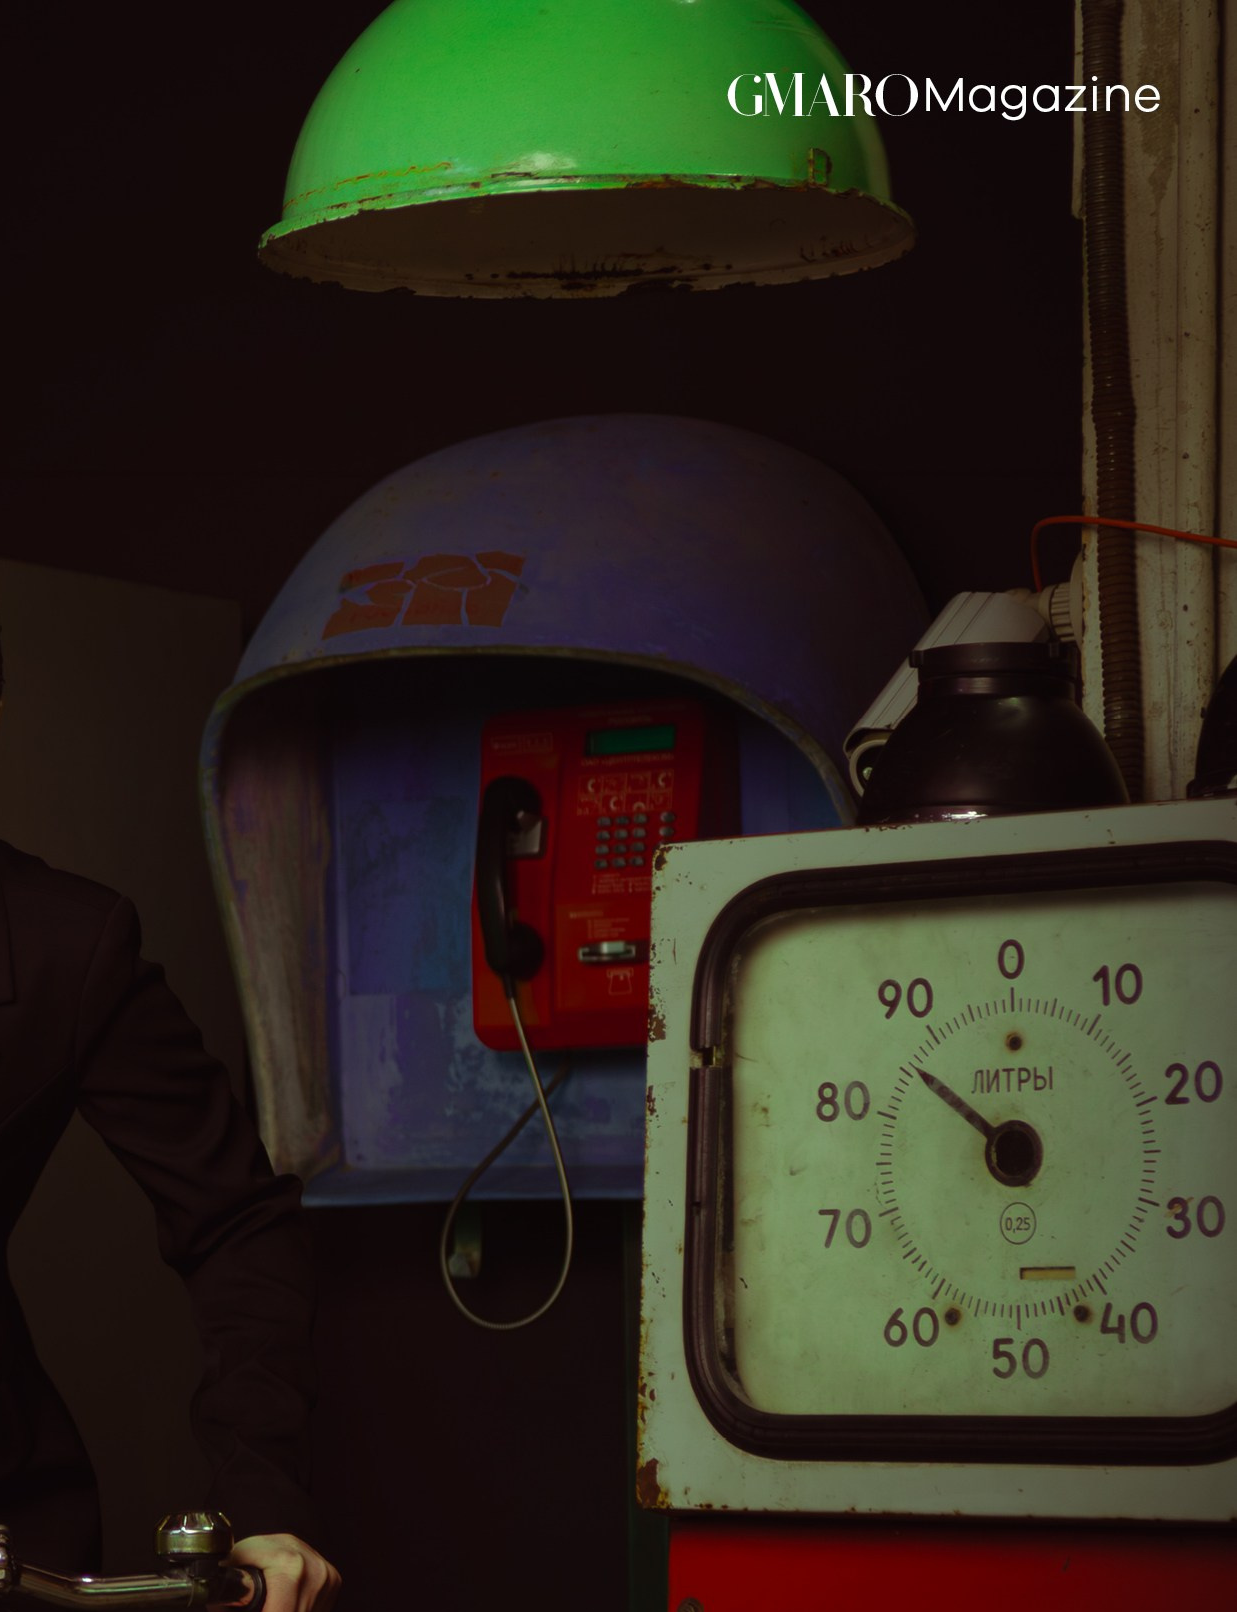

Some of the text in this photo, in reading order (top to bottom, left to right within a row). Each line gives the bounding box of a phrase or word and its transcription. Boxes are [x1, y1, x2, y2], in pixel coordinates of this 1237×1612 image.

[998, 939, 1025, 980] 0
[877, 977, 934, 1019] 90
[1093, 963, 1143, 1006] 10
[816, 1080, 871, 1122] 80
[971, 1066, 1054, 1094] ЛИТРЫ
[1164, 1060, 1223, 1105] 20
[818, 1207, 872, 1249] 70
[1004, 1215, 1031, 1233] 0,25
[1166, 1195, 1226, 1239] 30
[883, 1306, 940, 1348] 60
[1100, 1301, 1159, 1344] 40
[991, 1337, 1050, 1379] 50
